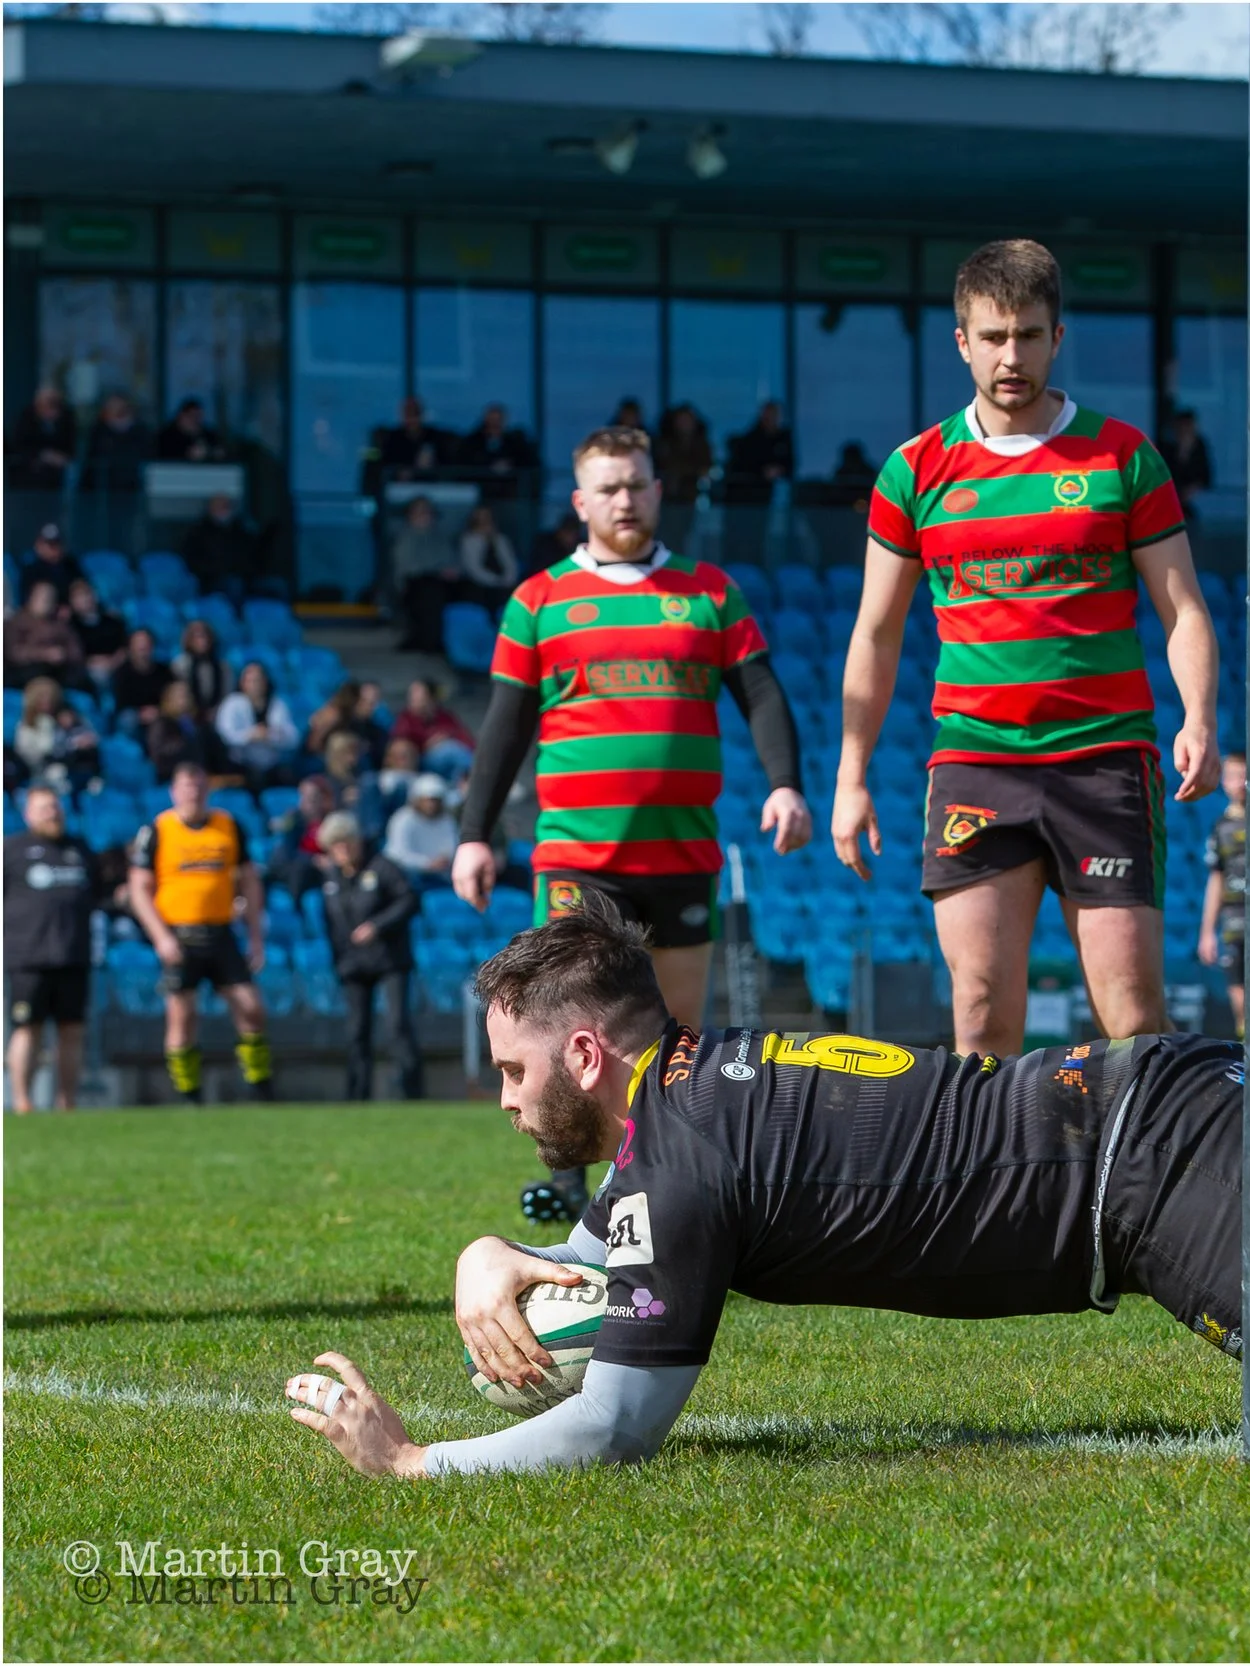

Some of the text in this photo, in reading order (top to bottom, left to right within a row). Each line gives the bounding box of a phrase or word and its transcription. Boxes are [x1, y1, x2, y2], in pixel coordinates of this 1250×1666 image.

[962, 546, 1024, 562] BELOW
[964, 556, 1112, 588] SERVICES
[1087, 856, 1133, 878] KIT
[761, 1029, 915, 1077] 5
